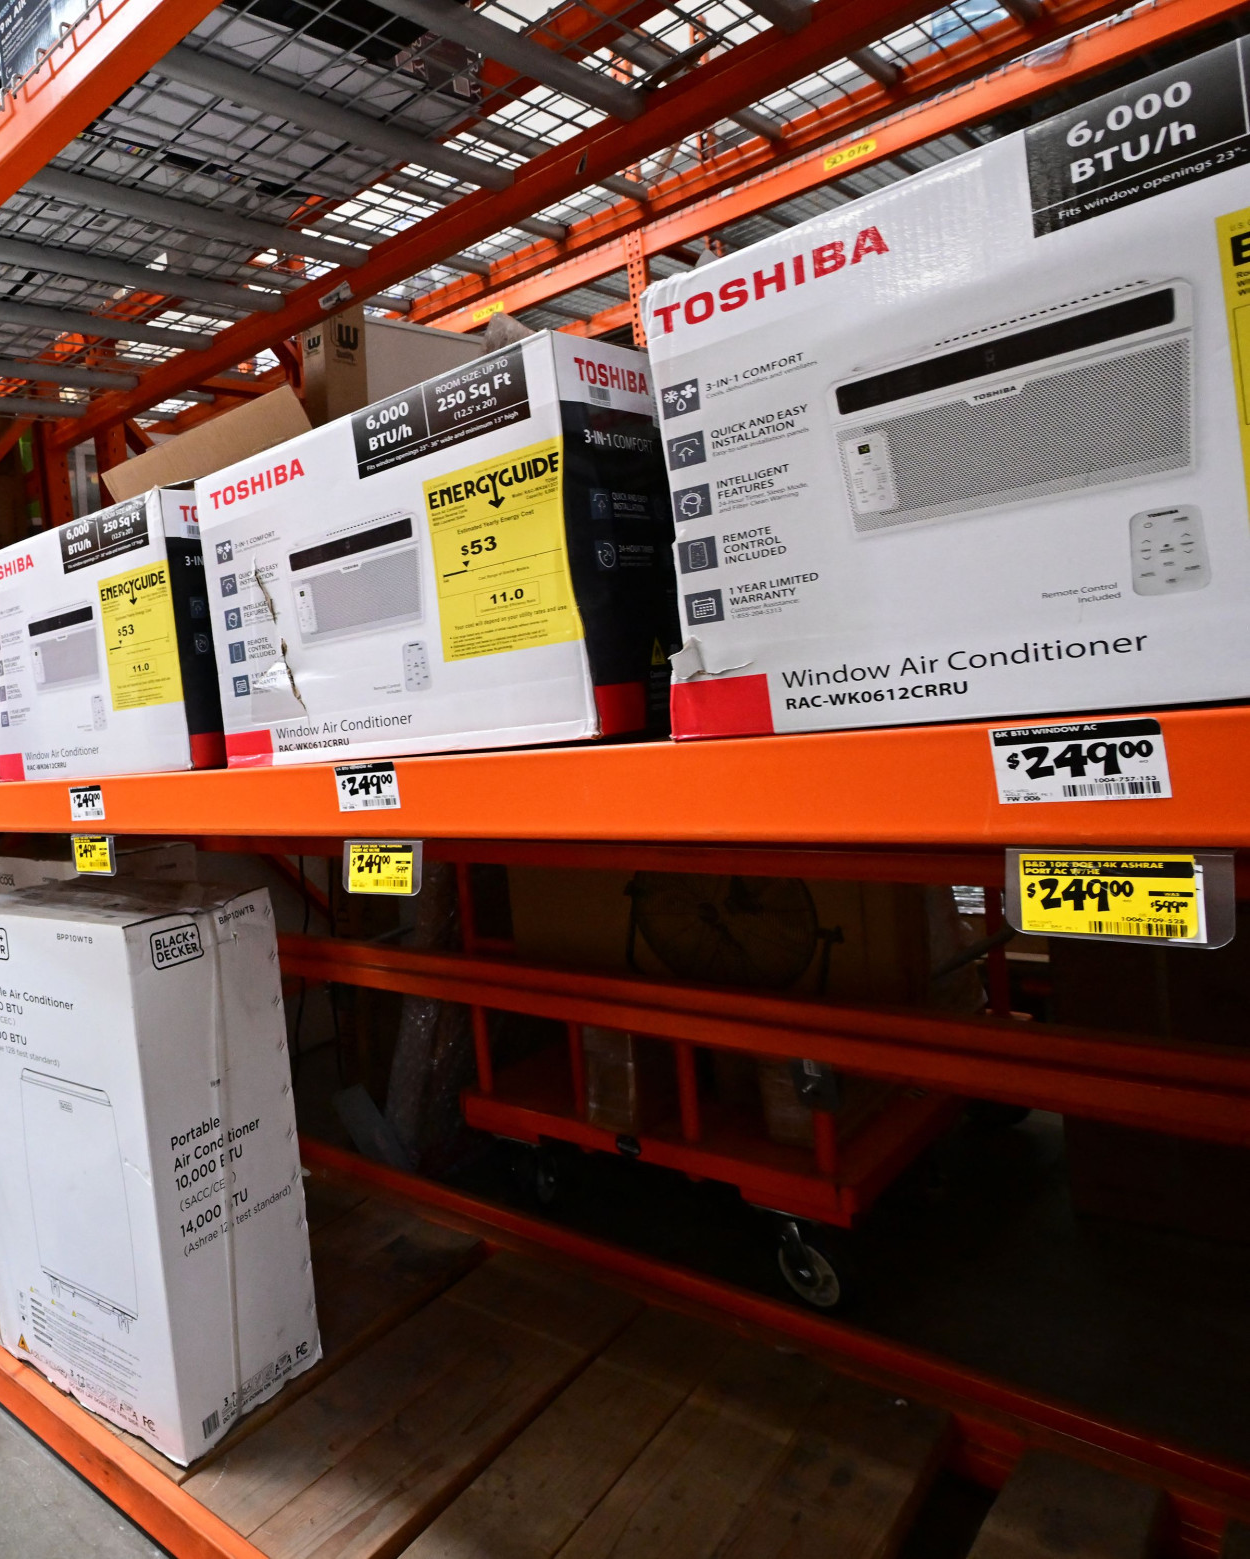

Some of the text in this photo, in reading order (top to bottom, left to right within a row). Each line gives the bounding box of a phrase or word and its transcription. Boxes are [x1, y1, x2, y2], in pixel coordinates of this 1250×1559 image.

[1066, 81, 1192, 148] 6,000
[1069, 121, 1196, 184] BTU/h
[1058, 207, 1082, 220] Fits
[1084, 186, 1140, 209] window
[1142, 159, 1213, 191] openings
[653, 225, 891, 335] TOSHIBA
[435, 358, 508, 395] ROOM SIZE: UP TO
[574, 357, 649, 396] TOSHIBA
[705, 351, 804, 393] 3-IN-1 COMFORT
[437, 371, 512, 412] 250 Sq Ft
[973, 385, 1017, 401] TOSHIBA
[366, 401, 409, 430] 6,000
[710, 404, 808, 439] QUICK AND EASY
[368, 423, 412, 451] BTU/h
[375, 455, 395, 468] window
[439, 434, 454, 445] wide
[504, 410, 519, 421] high
[583, 429, 653, 454] 3-IN-1 COMFORT
[711, 419, 795, 450] INSTALLATION
[209, 457, 305, 511] TOSHIBA
[428, 451, 559, 510] ENERGYGUIDE
[716, 463, 790, 489] INTELLIGENT
[718, 479, 774, 500] FEATURES
[66, 524, 90, 540] 6,000
[103, 512, 141, 534] 250 Sq Ft
[457, 509, 534, 535] Estimated Yearly Energy Cost
[249, 531, 276, 545] COMFORT
[460, 535, 498, 556] $53
[722, 526, 772, 543] REMOTE
[724, 536, 782, 554] CONTROL
[67, 541, 92, 556] BTU/h
[725, 545, 788, 565] INCLUDED
[265, 563, 279, 573] EASY
[100, 570, 167, 602] ENERGYGUIDE
[729, 572, 819, 595] 1 YEAR LIMITED
[1042, 582, 1118, 599] Remote Control
[489, 588, 525, 605] 11.0
[729, 587, 796, 606] WARRANTY
[1078, 592, 1121, 603] Included
[244, 608, 269, 618] FEATURES
[117, 624, 135, 637] $53
[248, 650, 276, 660] INCLUDED
[782, 634, 1149, 690] Window Air Conditioner
[132, 663, 150, 673] 11.0
[785, 680, 968, 711] RAC-WK0612CRRU
[276, 713, 413, 740] Window Air Conditioner
[994, 724, 1098, 739] 6K BTU WINDOW AC
[25, 745, 99, 761] Window Air Conditioner
[278, 738, 350, 753] RAC-WK0612CRRU
[1094, 776, 1157, 784] 1004-757-153
[1121, 916, 1185, 925] 1006-709-528
[56, 933, 94, 945] BPP10WTB
[155, 932, 196, 950] BLACK+
[157, 943, 199, 963] DECKER
[6, 1003, 23, 1015] BTU
[10, 989, 21, 1000] Air
[22, 992, 74, 1011] Conditioner
[10, 1033, 27, 1046] BTU
[170, 1117, 220, 1151] Portable
[174, 1118, 260, 1172] Air Condtioner
[175, 1159, 217, 1191] 10,000
[179, 1171, 237, 1212] (SACC/CE)
[180, 1204, 222, 1237] 14,000
[183, 1185, 292, 1257] (Ashrae test standard)
